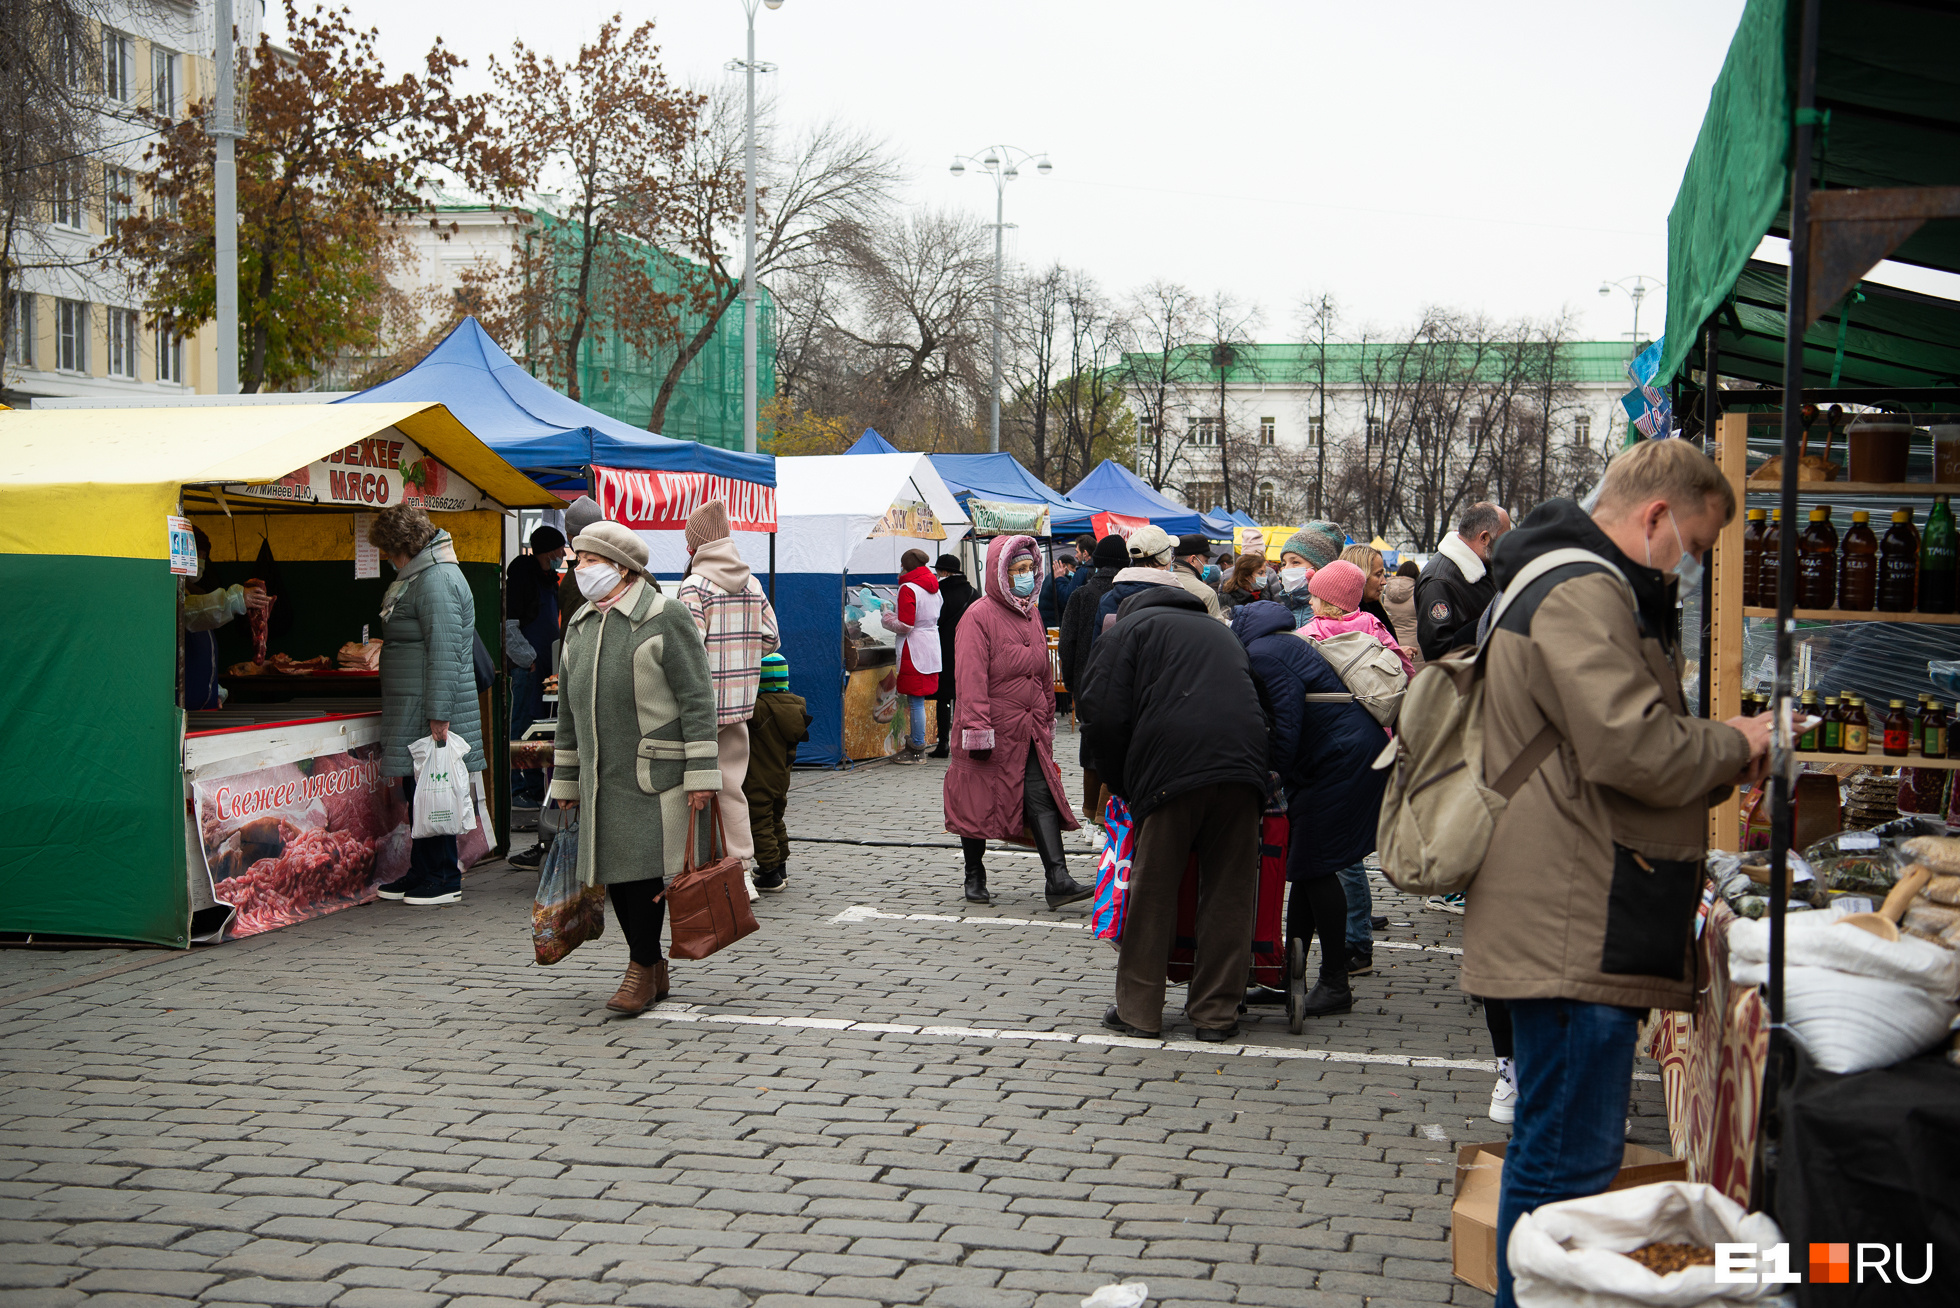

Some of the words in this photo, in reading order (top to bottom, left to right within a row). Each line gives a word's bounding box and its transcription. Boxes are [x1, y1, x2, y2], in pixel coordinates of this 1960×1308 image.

[320, 437, 404, 470] ВЕЖЕЕ
[260, 484, 293, 498] Минеев
[329, 469, 389, 504] МЯСО
[600, 469, 655, 521] ГУСИ
[657, 473, 705, 522] УТКИ
[707, 474, 776, 531] ИНДЮКИ
[214, 779, 296, 822] Свежее
